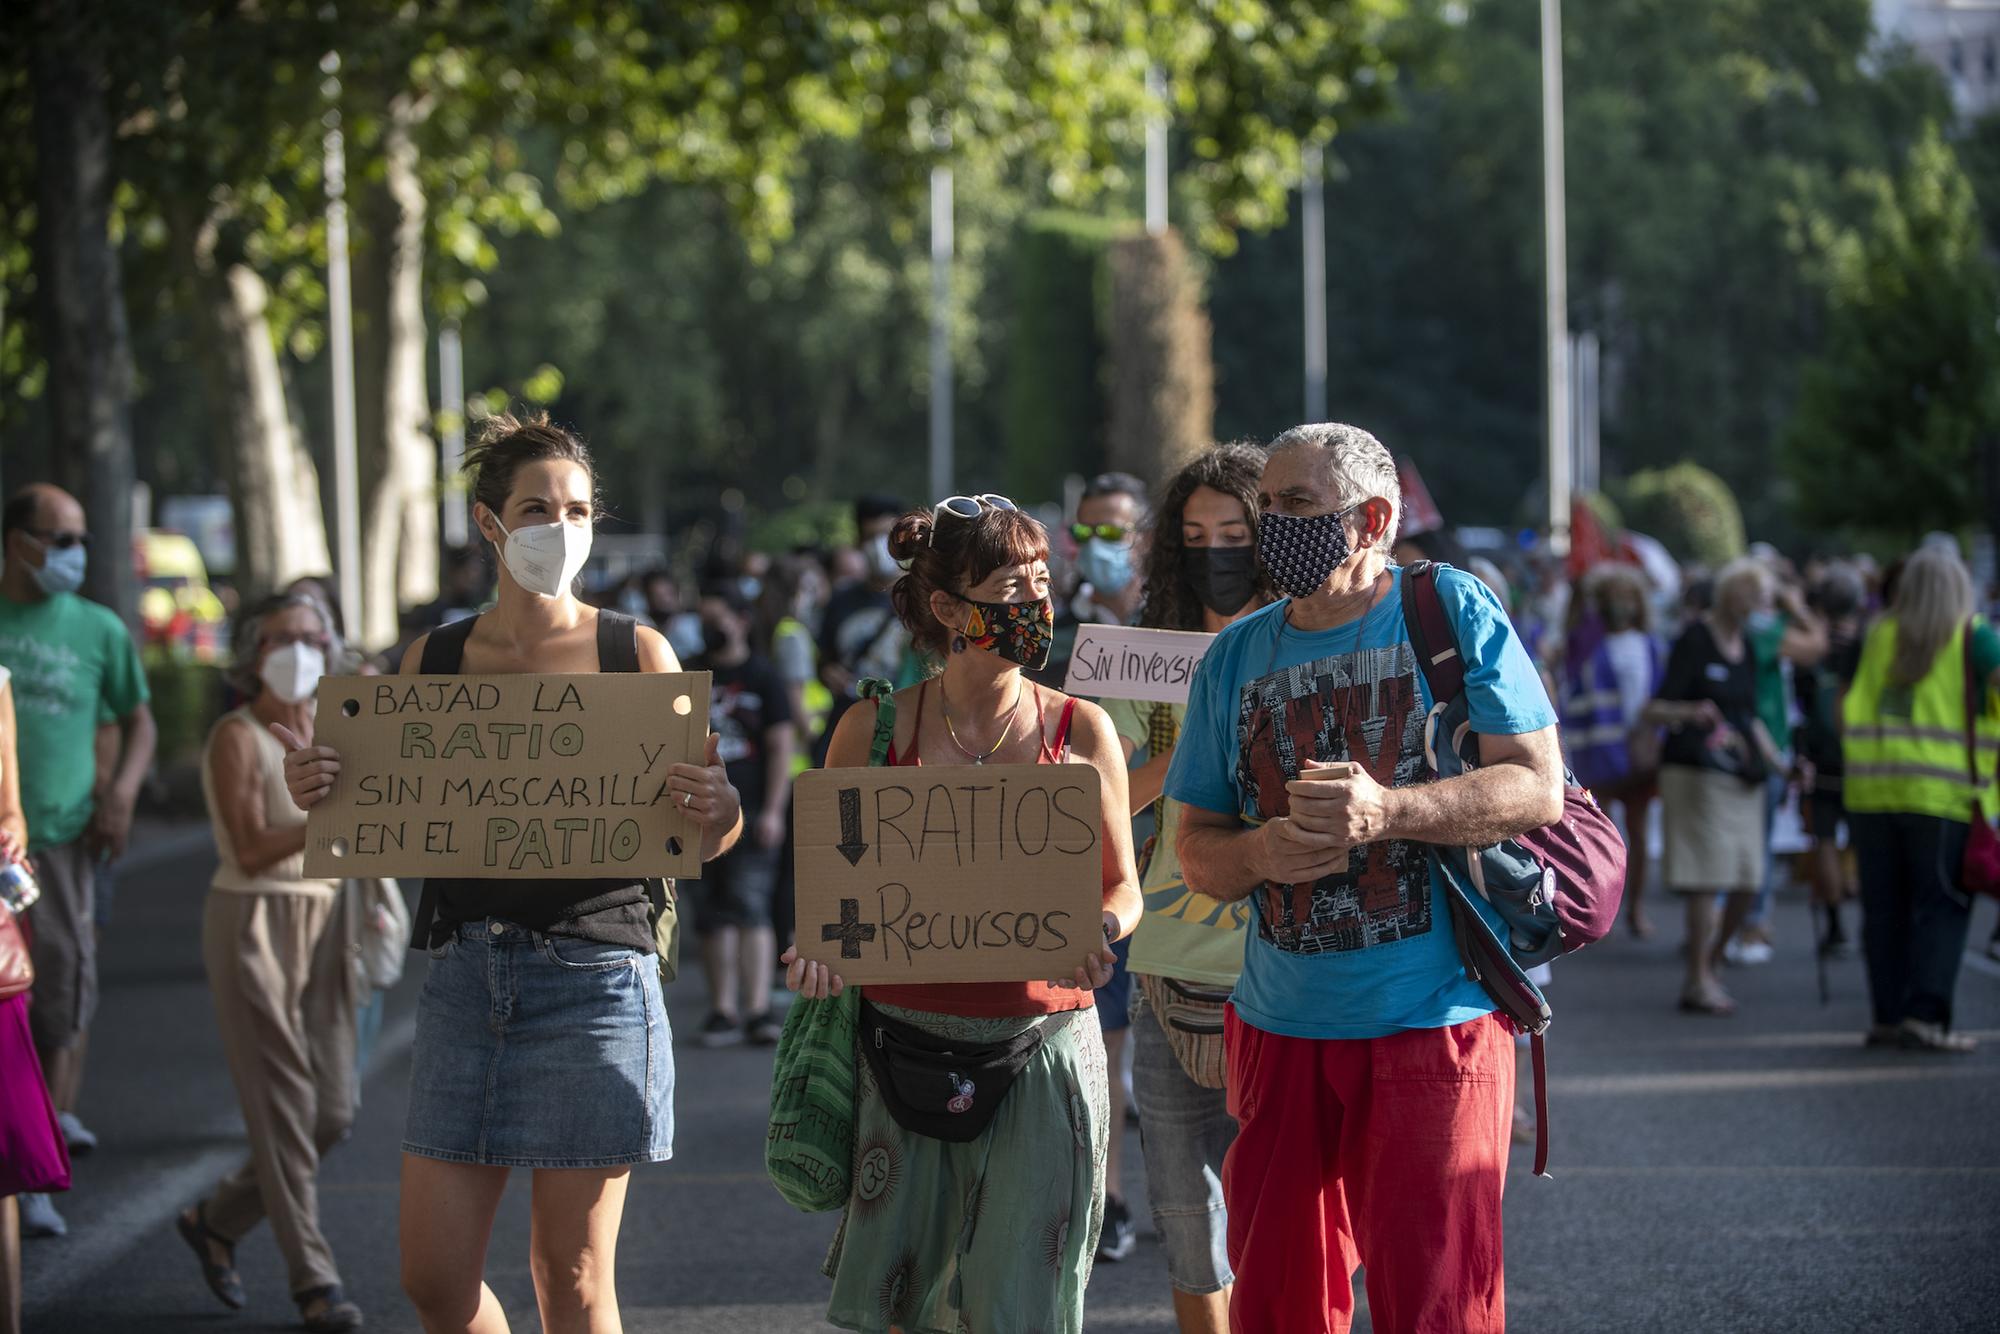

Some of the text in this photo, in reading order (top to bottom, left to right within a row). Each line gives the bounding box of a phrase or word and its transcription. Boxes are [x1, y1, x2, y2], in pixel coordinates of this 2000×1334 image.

[374, 682, 585, 715] BAJAD LA
[400, 722, 584, 760] RATIO
[355, 774, 423, 806] SIN
[354, 818, 641, 870] EN EL PATIO
[876, 883, 1071, 967] Recursos
